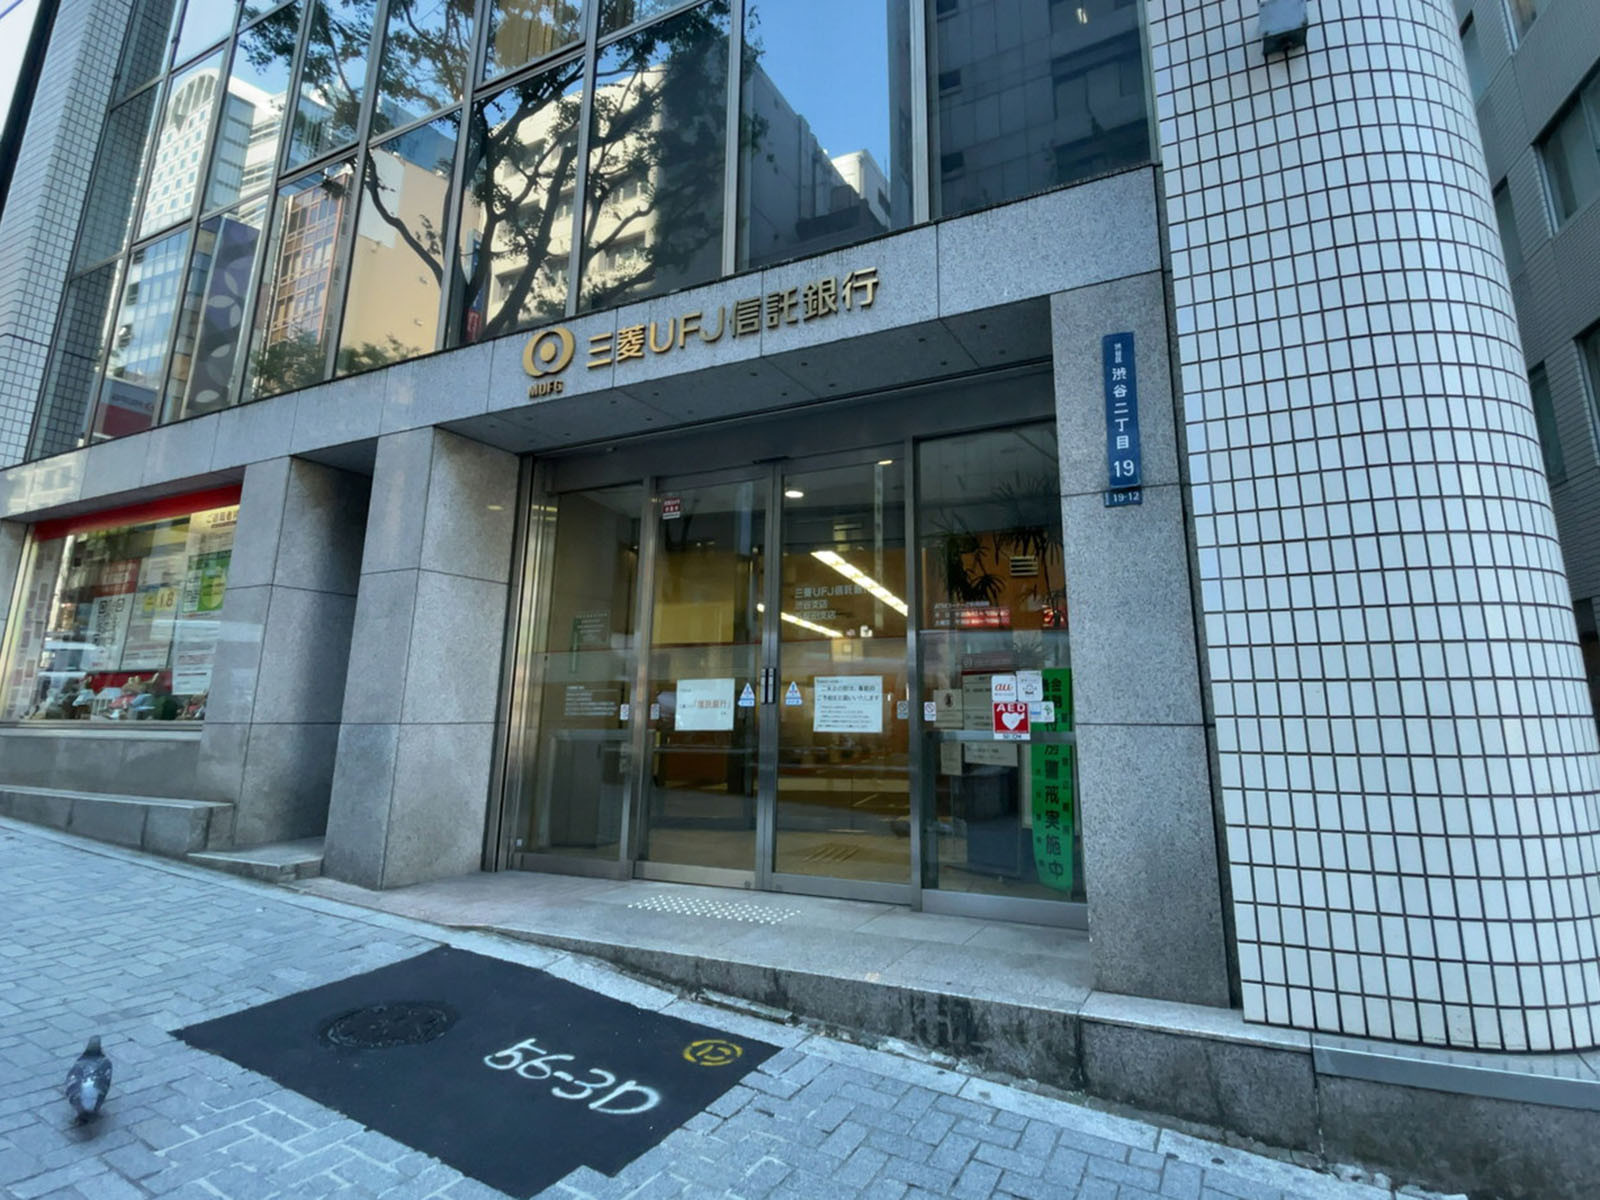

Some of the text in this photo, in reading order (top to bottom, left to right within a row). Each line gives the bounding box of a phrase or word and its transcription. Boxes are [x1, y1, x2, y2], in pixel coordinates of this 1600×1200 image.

[586, 266, 880, 369] 三菱UFJ信託銀行
[527, 379, 564, 398] MUFG
[1111, 366, 1131, 450] 渋谷二丁目
[1113, 458, 1136, 478] 19
[1112, 490, 1141, 503] 19-12
[996, 703, 1026, 713] AED
